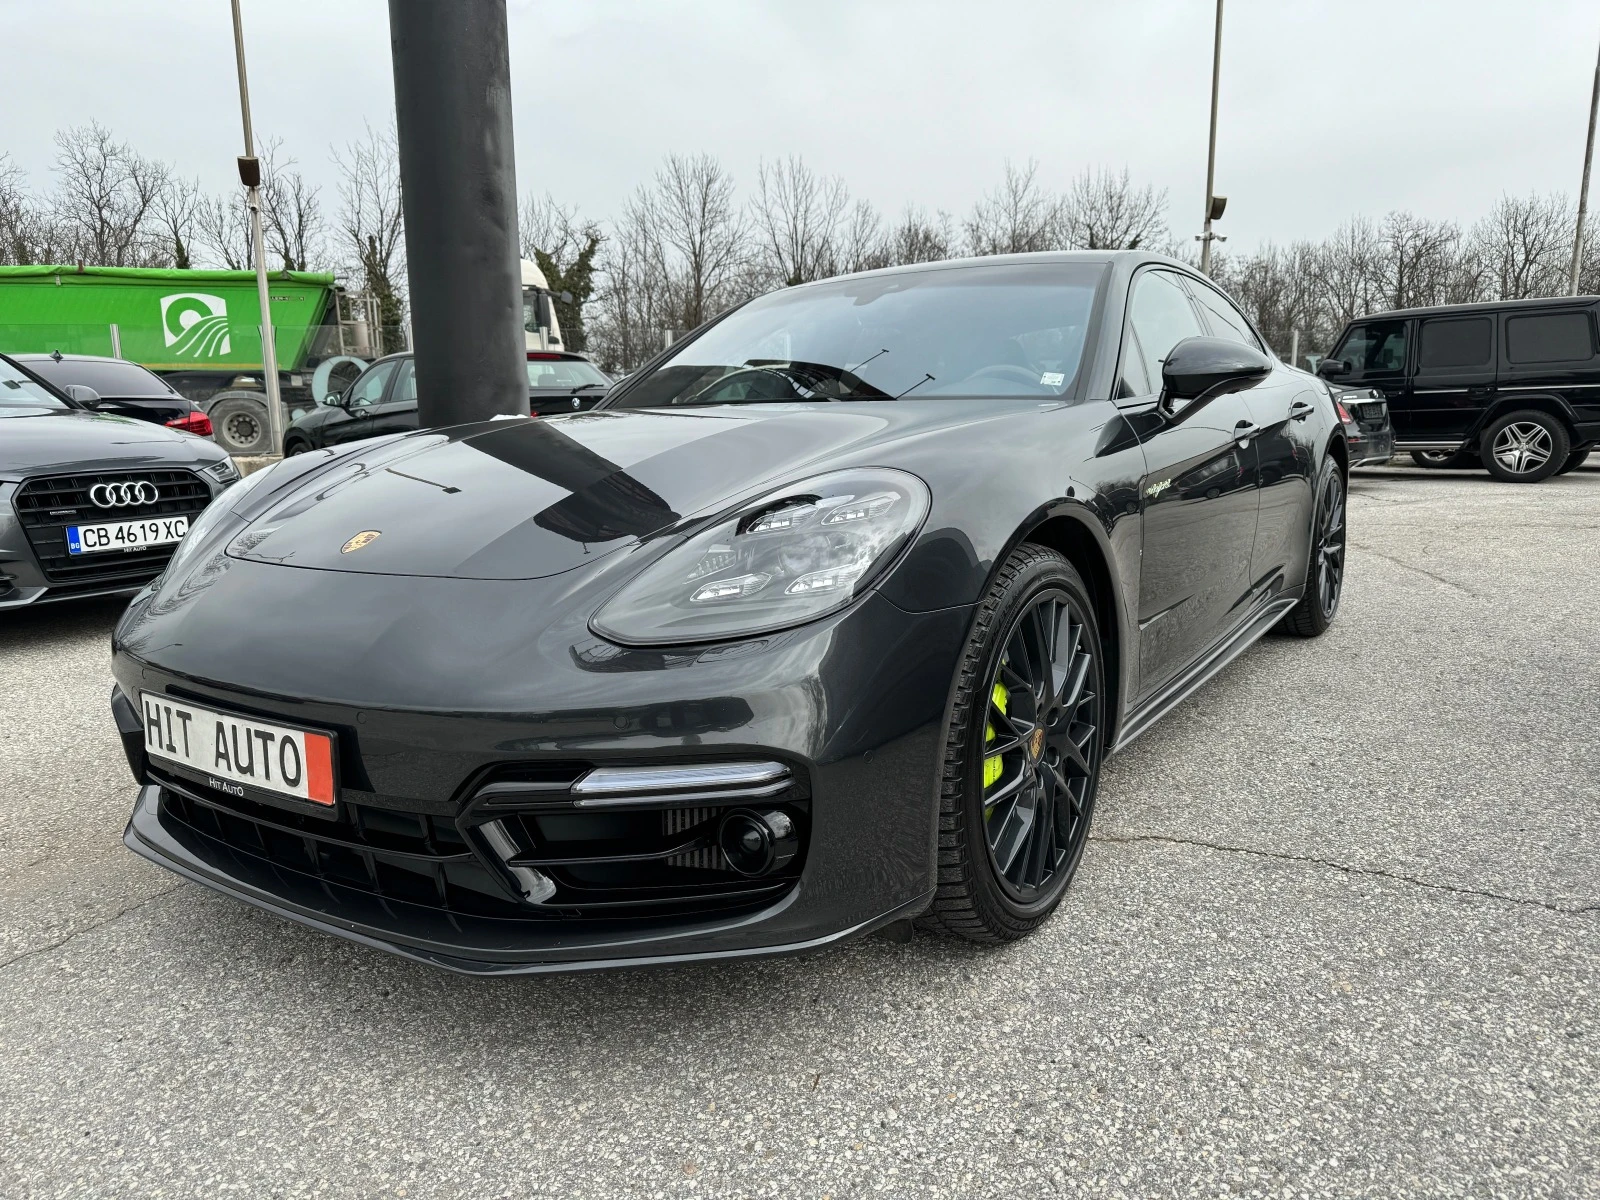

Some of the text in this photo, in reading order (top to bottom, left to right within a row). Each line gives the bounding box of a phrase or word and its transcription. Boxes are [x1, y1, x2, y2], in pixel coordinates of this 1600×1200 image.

[71, 542, 80, 550] BG
[83, 520, 186, 548] CB 4619 XC
[145, 700, 302, 788] HIT AUTO
